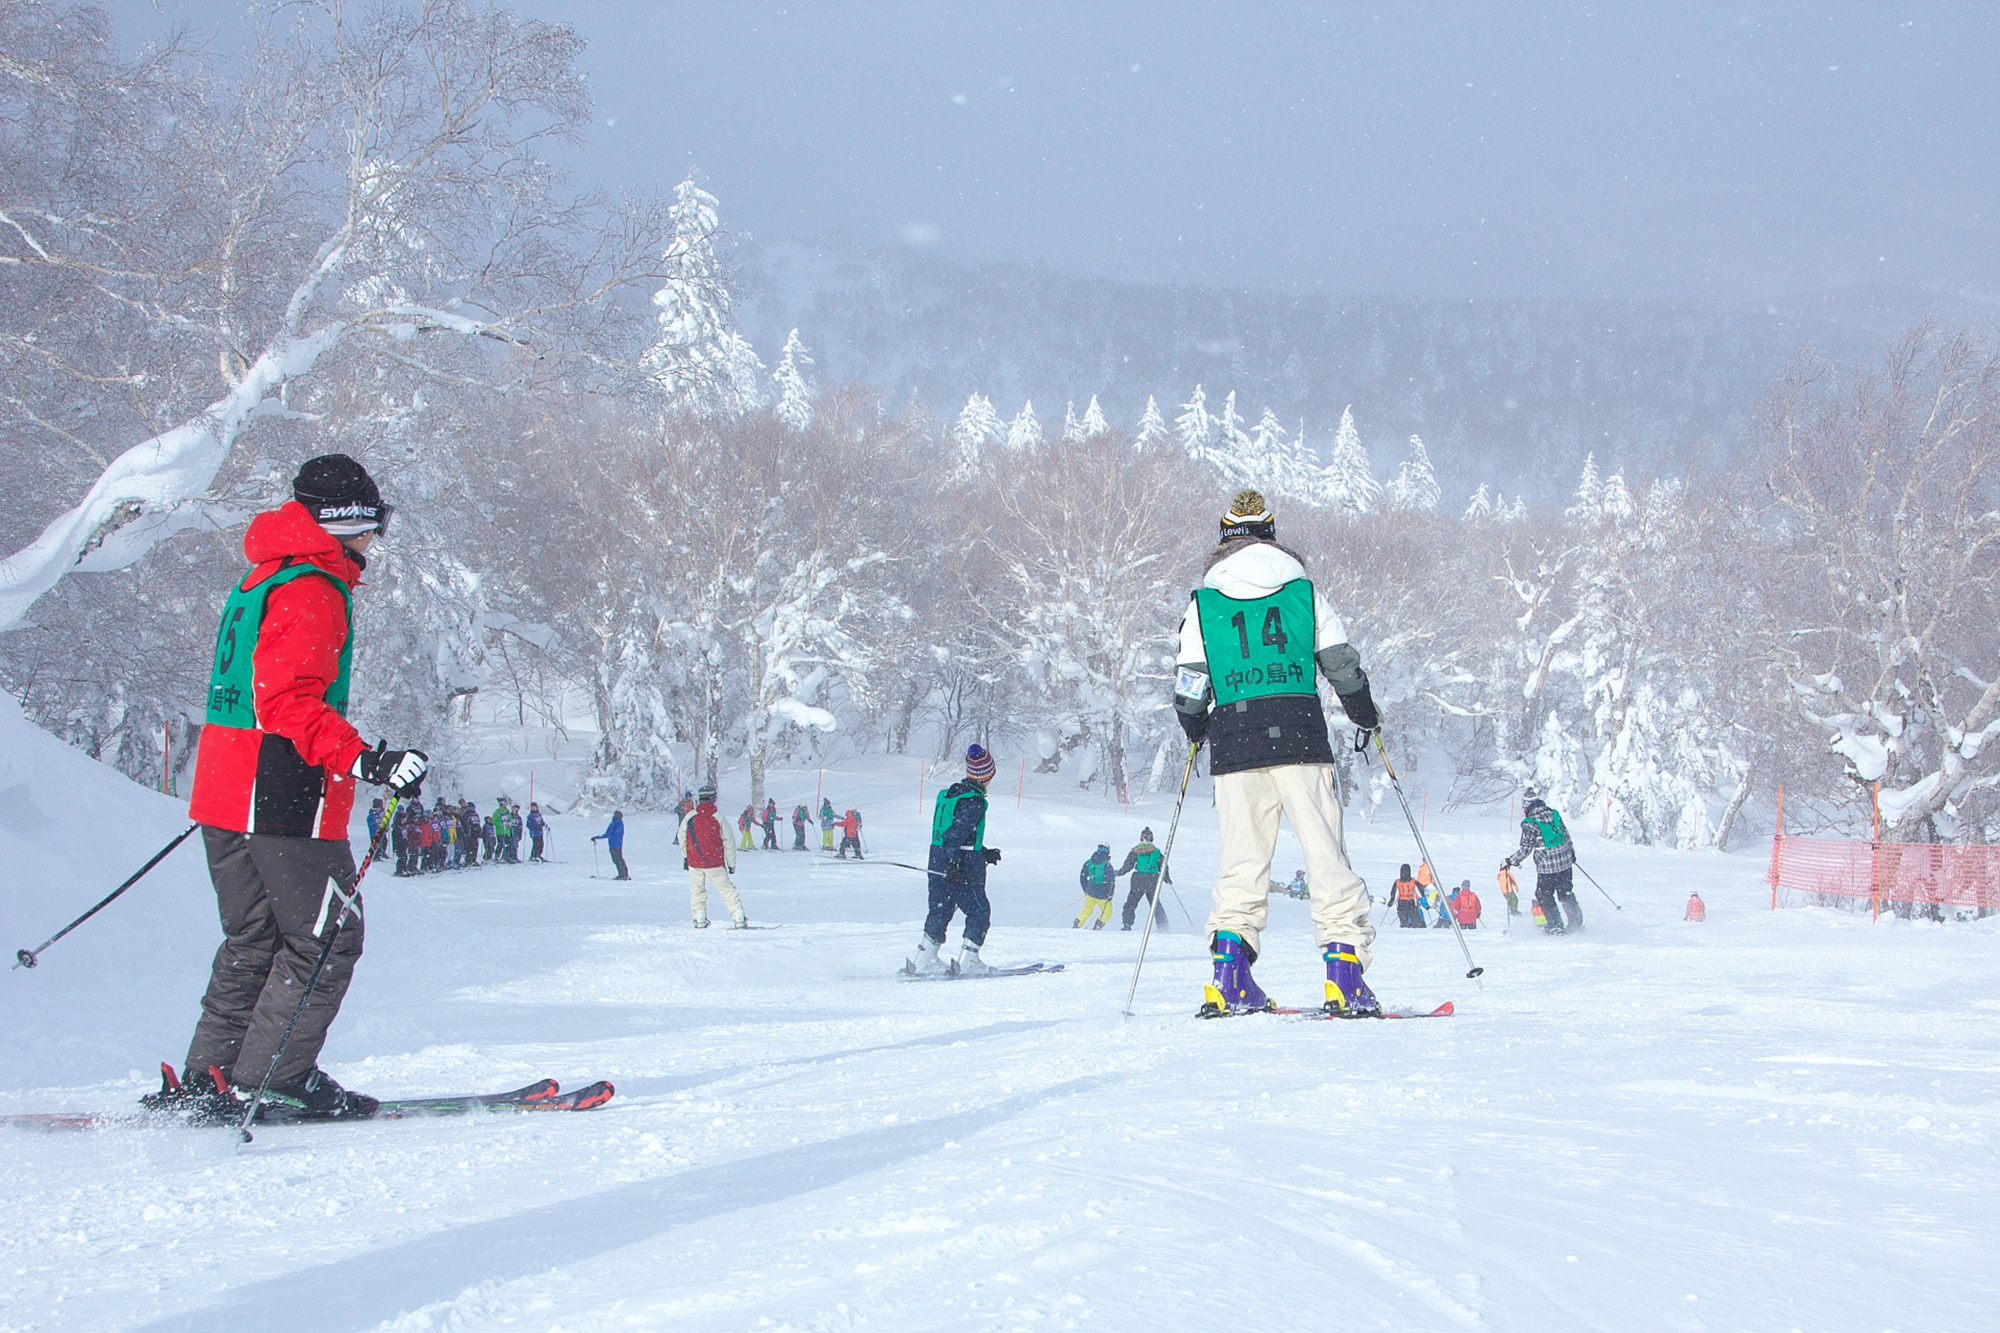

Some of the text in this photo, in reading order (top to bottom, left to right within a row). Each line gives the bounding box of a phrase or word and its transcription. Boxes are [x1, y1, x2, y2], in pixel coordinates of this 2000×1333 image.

[319, 505, 378, 519] SWANS
[1231, 606, 1288, 660] 14
[1225, 661, 1303, 693] 中の島中
